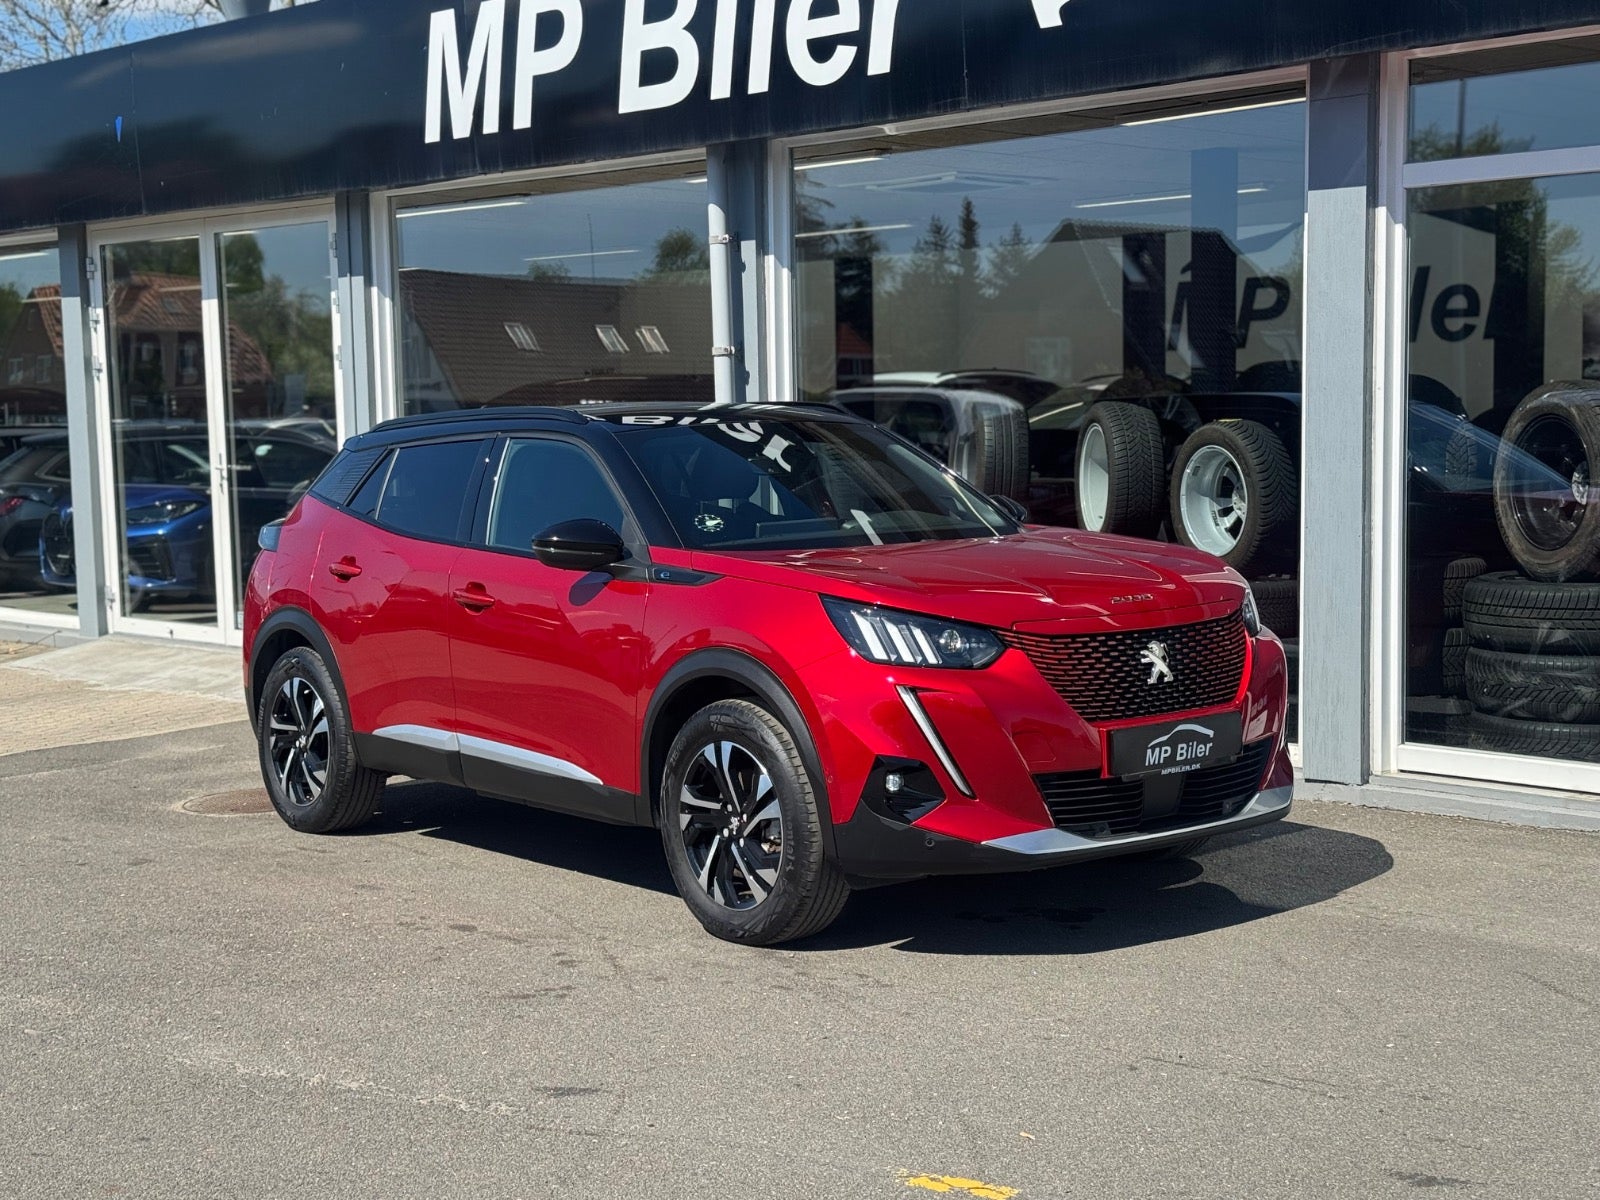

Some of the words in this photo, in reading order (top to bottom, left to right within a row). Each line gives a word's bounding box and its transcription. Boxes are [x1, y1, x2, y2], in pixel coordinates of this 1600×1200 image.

[424, 0, 583, 143] MP
[1145, 746, 1172, 766] MP
[1176, 740, 1213, 761] Biler
